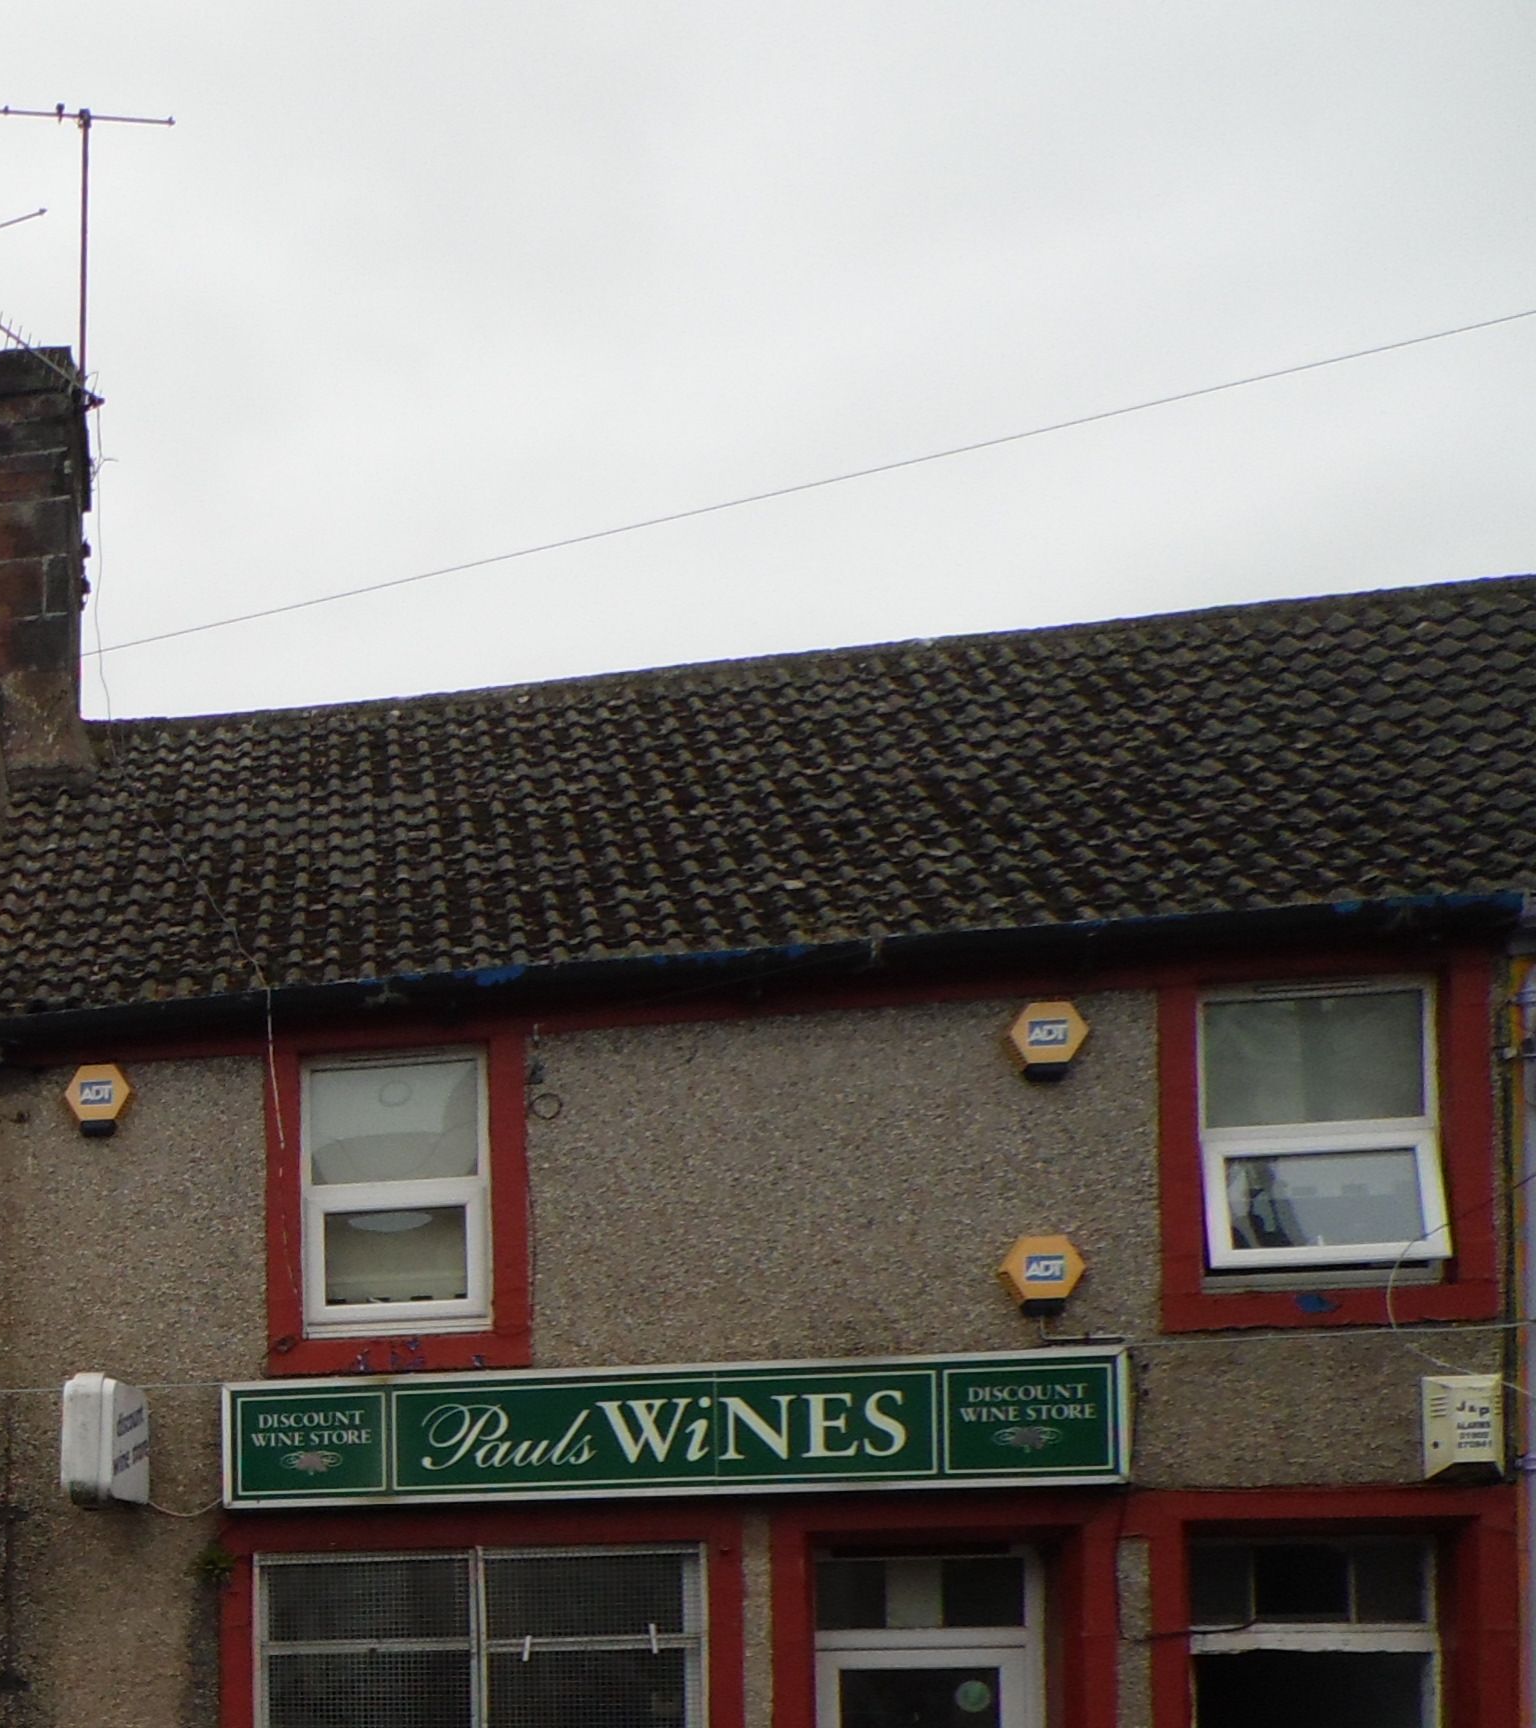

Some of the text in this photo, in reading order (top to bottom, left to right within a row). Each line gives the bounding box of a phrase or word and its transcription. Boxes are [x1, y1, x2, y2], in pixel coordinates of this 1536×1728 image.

[1028, 1024, 1068, 1042] ADT
[80, 1085, 112, 1101] ADT
[1026, 1259, 1064, 1277] ADT
[967, 1383, 1089, 1403] DISCOUNT
[258, 1410, 366, 1429] DISCOUNT
[959, 1403, 1097, 1423] WINE STORE
[251, 1429, 373, 1447] WINE STORE
[420, 1403, 598, 1471] Pauls
